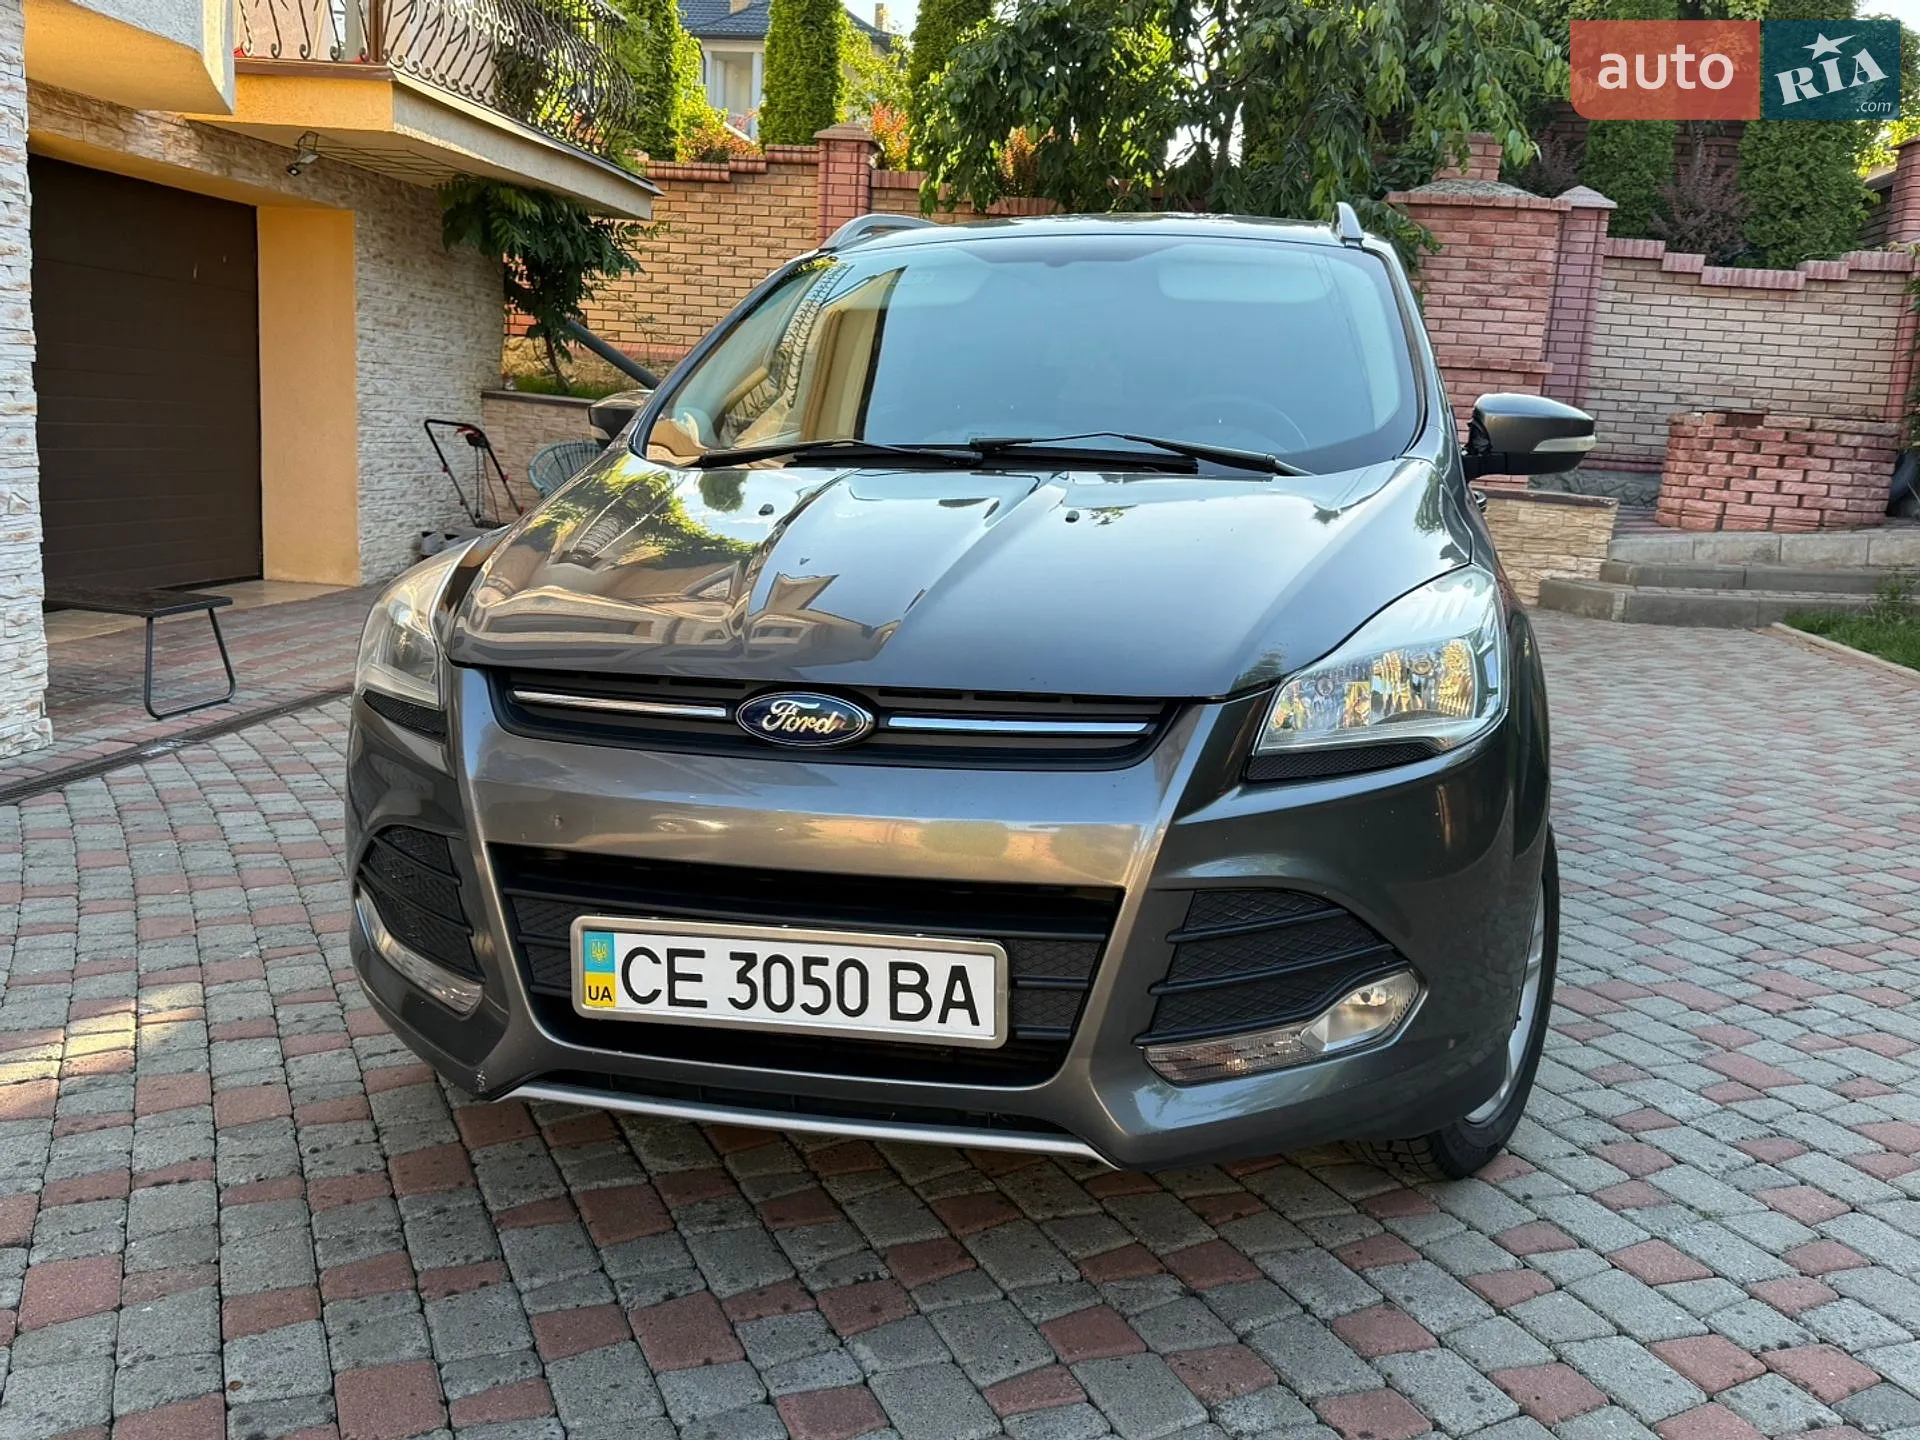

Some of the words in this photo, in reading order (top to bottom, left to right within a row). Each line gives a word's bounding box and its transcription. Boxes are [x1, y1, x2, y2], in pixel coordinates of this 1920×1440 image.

[762, 700, 841, 734] Ford
[588, 985, 614, 1003] UA
[621, 946, 708, 1009] CE
[728, 952, 870, 1018] 3050
[889, 961, 981, 1027] BA
